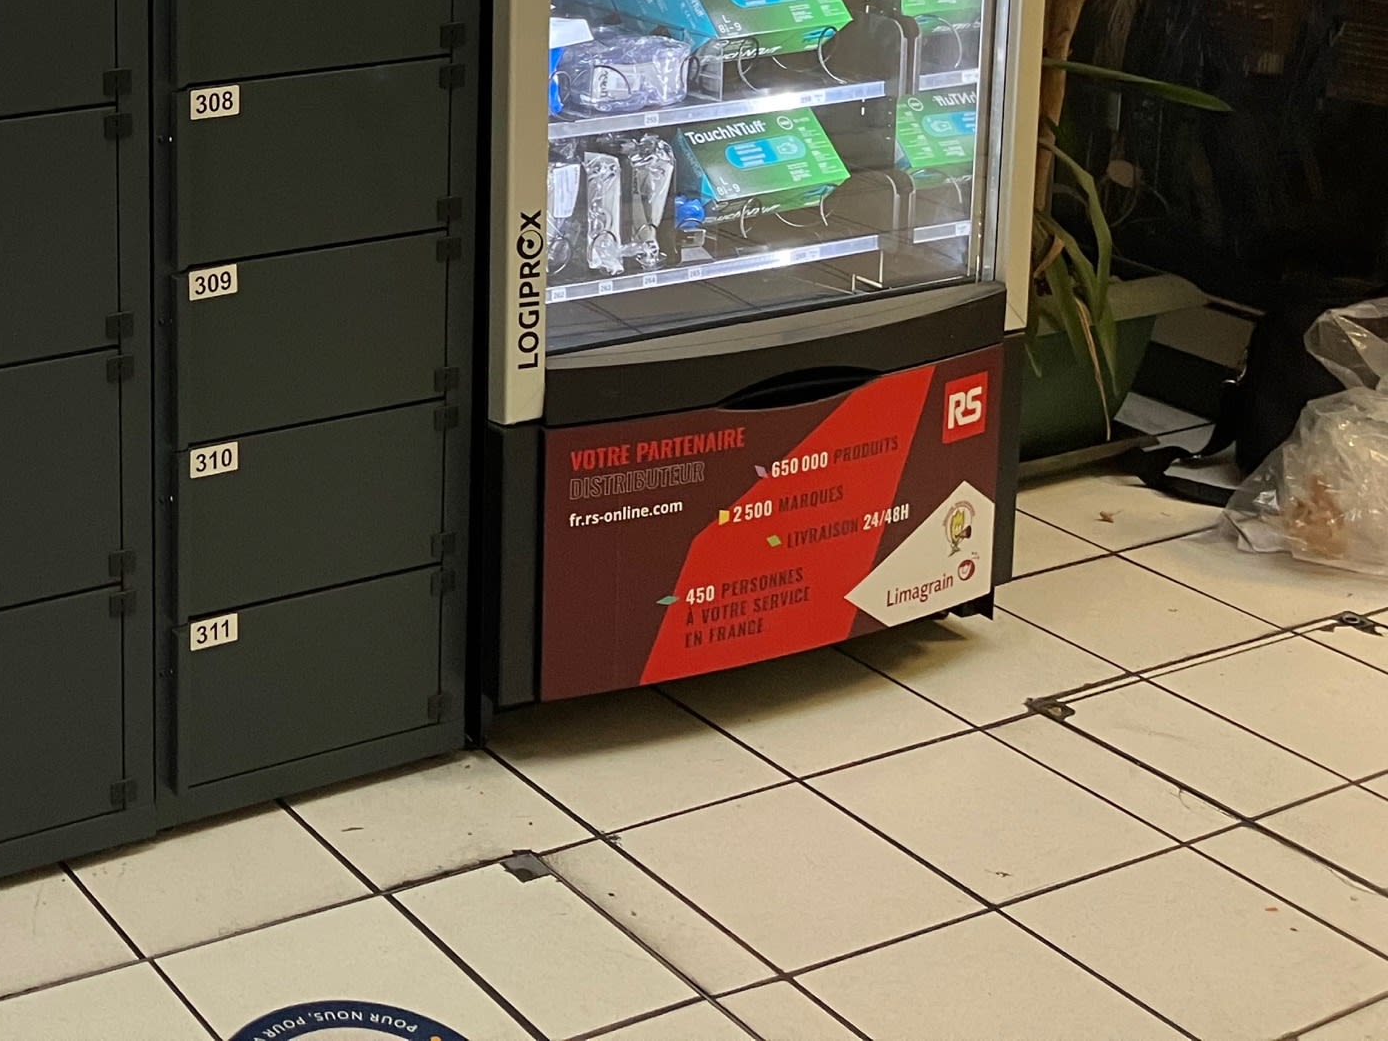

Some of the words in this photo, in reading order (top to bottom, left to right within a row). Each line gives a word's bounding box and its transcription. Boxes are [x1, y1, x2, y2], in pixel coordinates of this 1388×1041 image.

[723, 14, 731, 23] L
[195, 91, 234, 114] 308
[685, 120, 766, 146] TouchNTuff
[194, 271, 232, 295] 309
[516, 209, 544, 370] LOGIPROX
[947, 386, 983, 430] RS
[195, 448, 233, 473] 310
[570, 444, 630, 472] VOTRE
[636, 427, 746, 463] PARTENAIRE
[771, 457, 799, 478] 650
[801, 451, 828, 473] 000
[833, 435, 899, 465] PRODUITS
[569, 461, 705, 501] DISTRIBUTEUR
[569, 501, 683, 527] fr.rs-online.com
[732, 506, 743, 523] 2
[745, 500, 773, 521] 500
[778, 485, 844, 512] MARQUES
[787, 517, 859, 549] LIVRAISON
[863, 503, 910, 531] 24/48H
[685, 585, 715, 605] 450
[721, 567, 804, 599] PERSONNES
[886, 573, 954, 608] Limagrain
[701, 600, 746, 624] VOTRE
[753, 586, 810, 612] SERVICE
[196, 620, 231, 644] 311
[685, 629, 703, 648] EN
[709, 617, 764, 644] FRANCE
[262, 1016, 306, 1039] POUR
[307, 1010, 363, 1022] NOUS,
[369, 1012, 417, 1033] POUR
